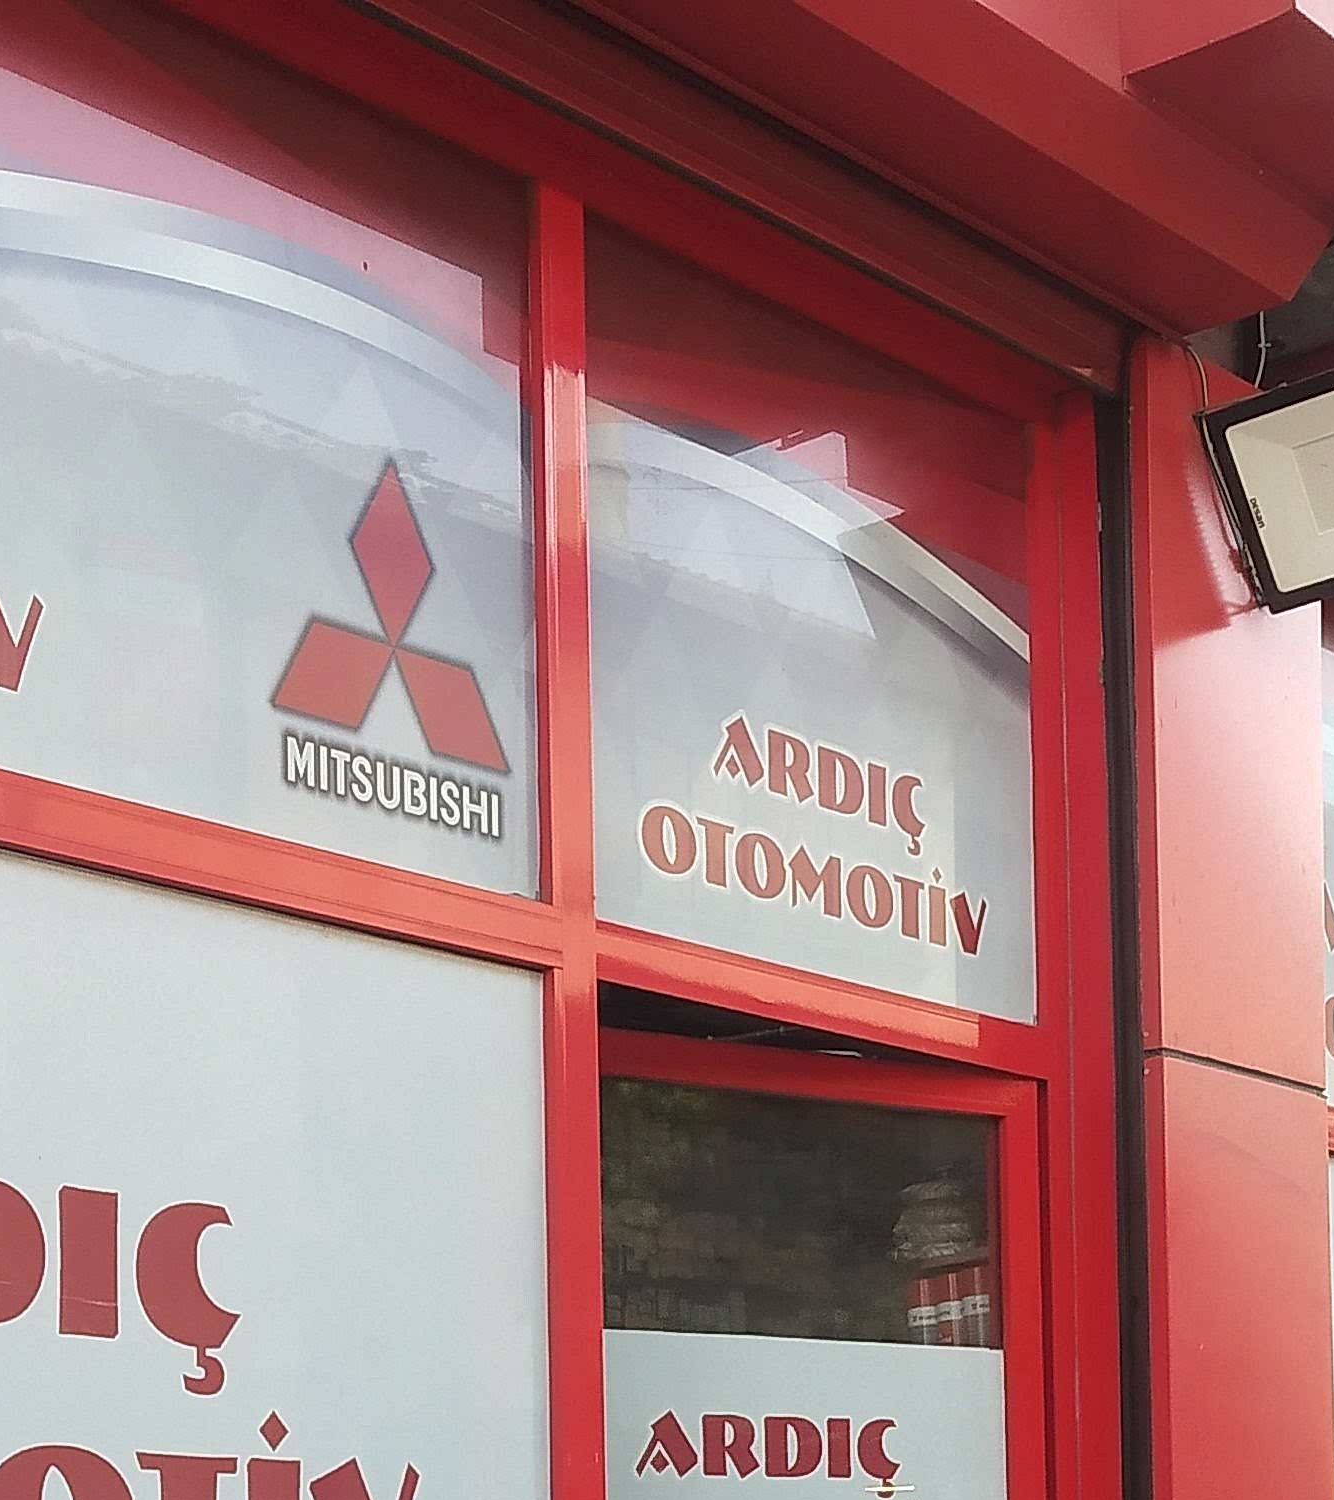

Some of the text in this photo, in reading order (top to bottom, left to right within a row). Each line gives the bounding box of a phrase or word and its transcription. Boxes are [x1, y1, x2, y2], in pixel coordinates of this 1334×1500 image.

[285, 735, 501, 838] MITSUBISHI
[713, 715, 926, 855] ARDIÇ
[641, 805, 987, 956] OTOMOTİV
[635, 1410, 901, 1499] ARDIÇ
